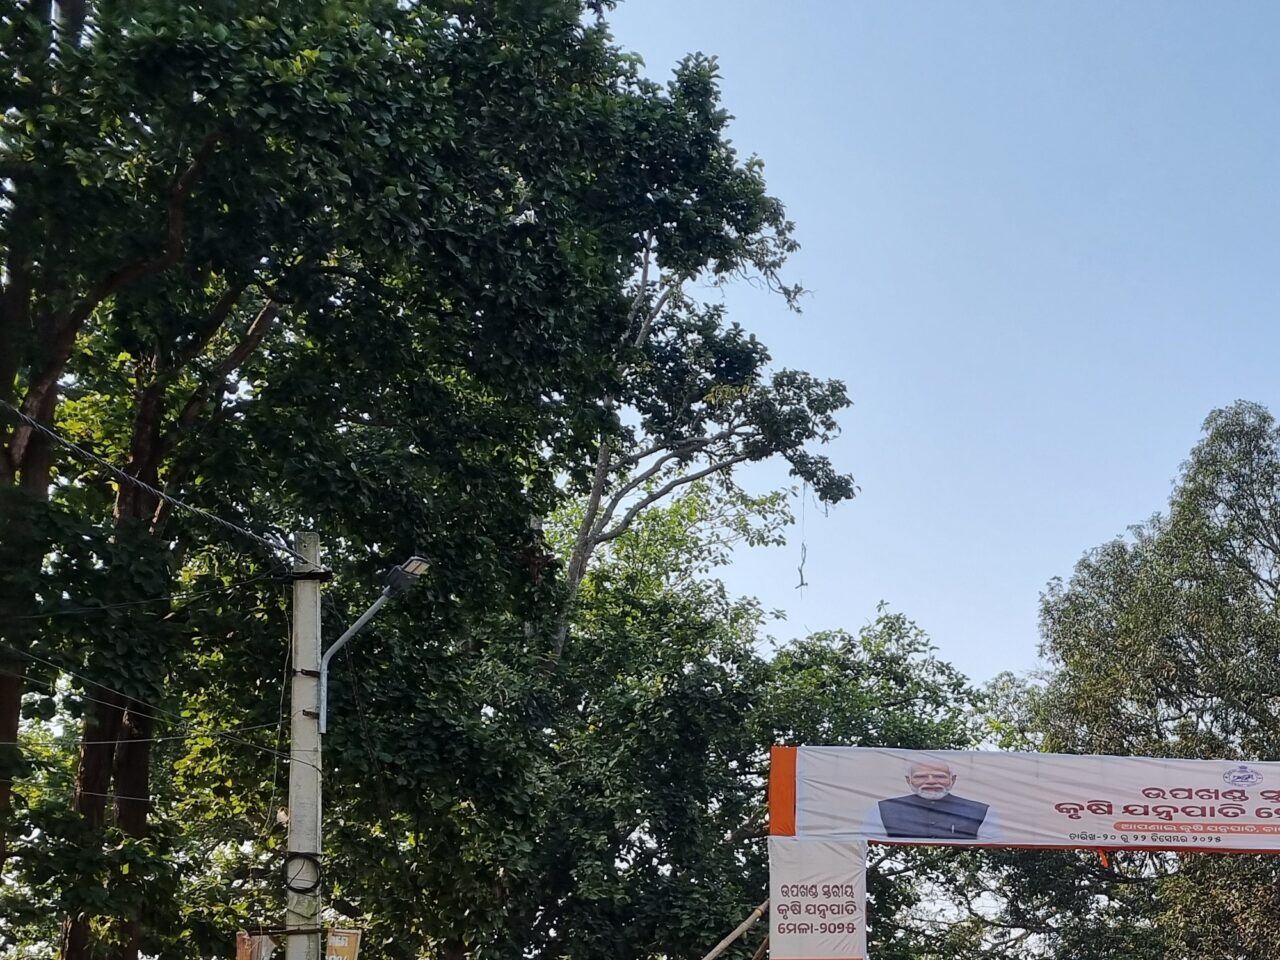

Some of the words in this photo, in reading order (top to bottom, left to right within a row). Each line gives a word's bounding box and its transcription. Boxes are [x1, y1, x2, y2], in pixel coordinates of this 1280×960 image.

[1141, 786, 1249, 802] ଉପଖଣ୍ଡ
[1054, 800, 1113, 820] କୃଷି
[1122, 803, 1246, 821] ଯନ୍ତ୍ରପାତି
[1133, 834, 1147, 842] ୨୨
[780, 884, 818, 898] ଉପଖଣ୍ଡ
[821, 884, 854, 899] ସ୍ତରୀୟ
[777, 900, 801, 920] କୃଷି
[805, 901, 857, 919] ଯନ୍ତ୍ରପାତି
[778, 922, 856, 934] ମେଳା-୨୦୨୫
